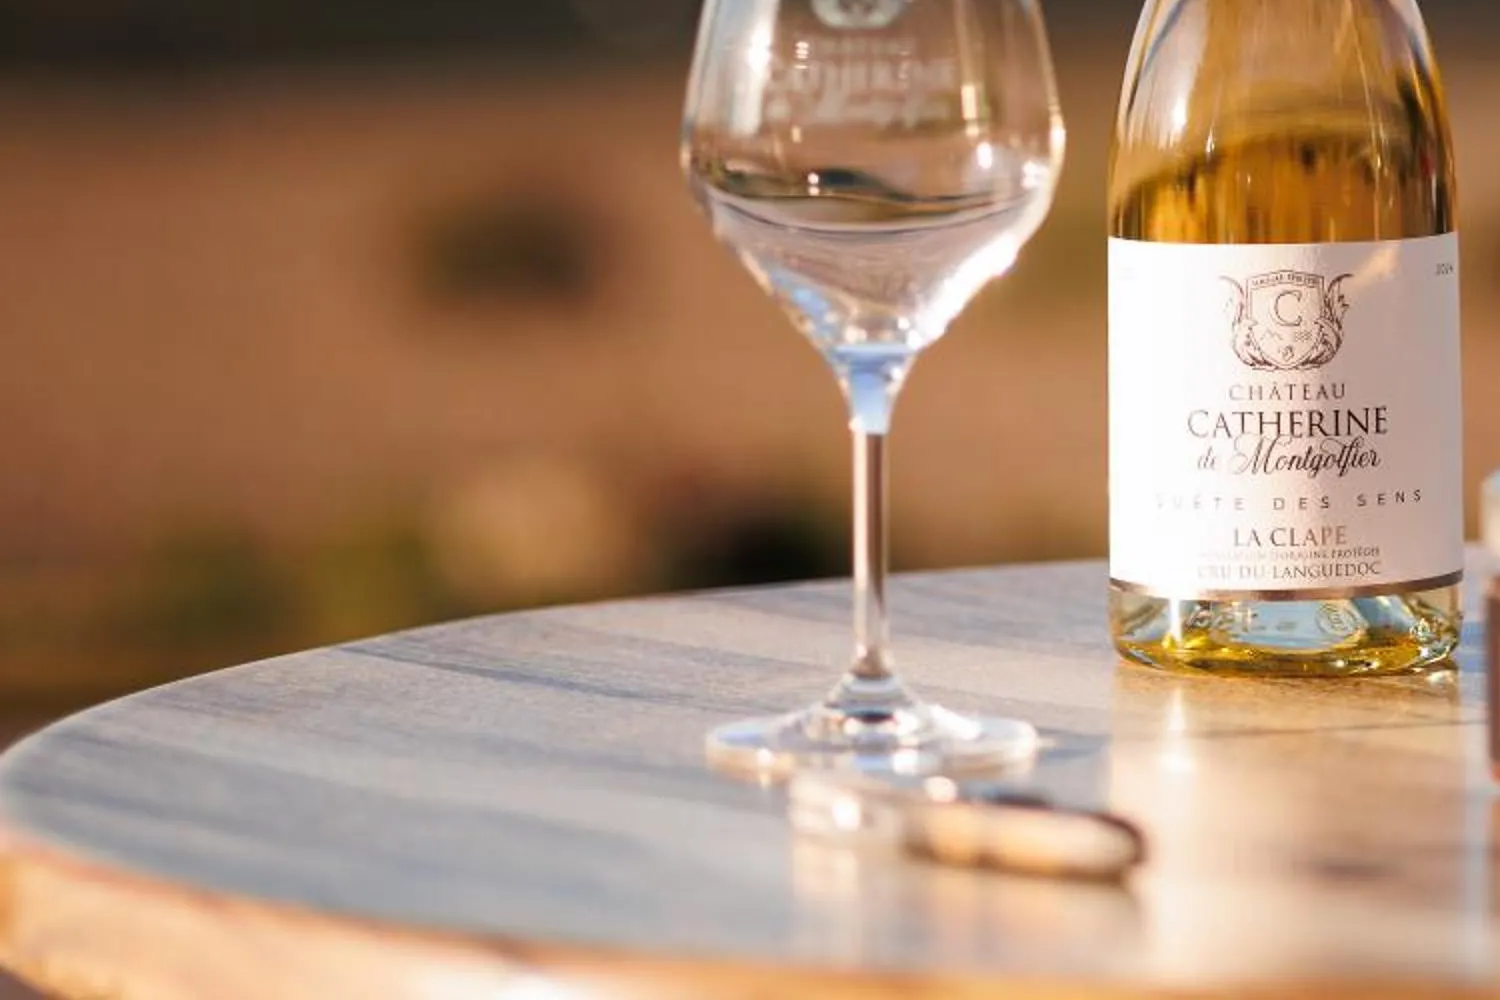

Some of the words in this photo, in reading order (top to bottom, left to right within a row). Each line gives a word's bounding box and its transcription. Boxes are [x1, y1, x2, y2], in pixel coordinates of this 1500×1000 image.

[1273, 289, 1303, 327] C
[1228, 381, 1346, 401] CHÂTEAU
[1187, 405, 1389, 438] CATHERINE
[1197, 445, 1217, 471] de
[1229, 432, 1382, 479] Montgolfier
[1273, 495, 1329, 511] DES
[1357, 489, 1421, 507] SENS
[1233, 527, 1262, 548] LA
[1269, 525, 1348, 548] CLAPE
[1239, 564, 1265, 580] DU
[1272, 561, 1382, 579] LANGUEDOC
